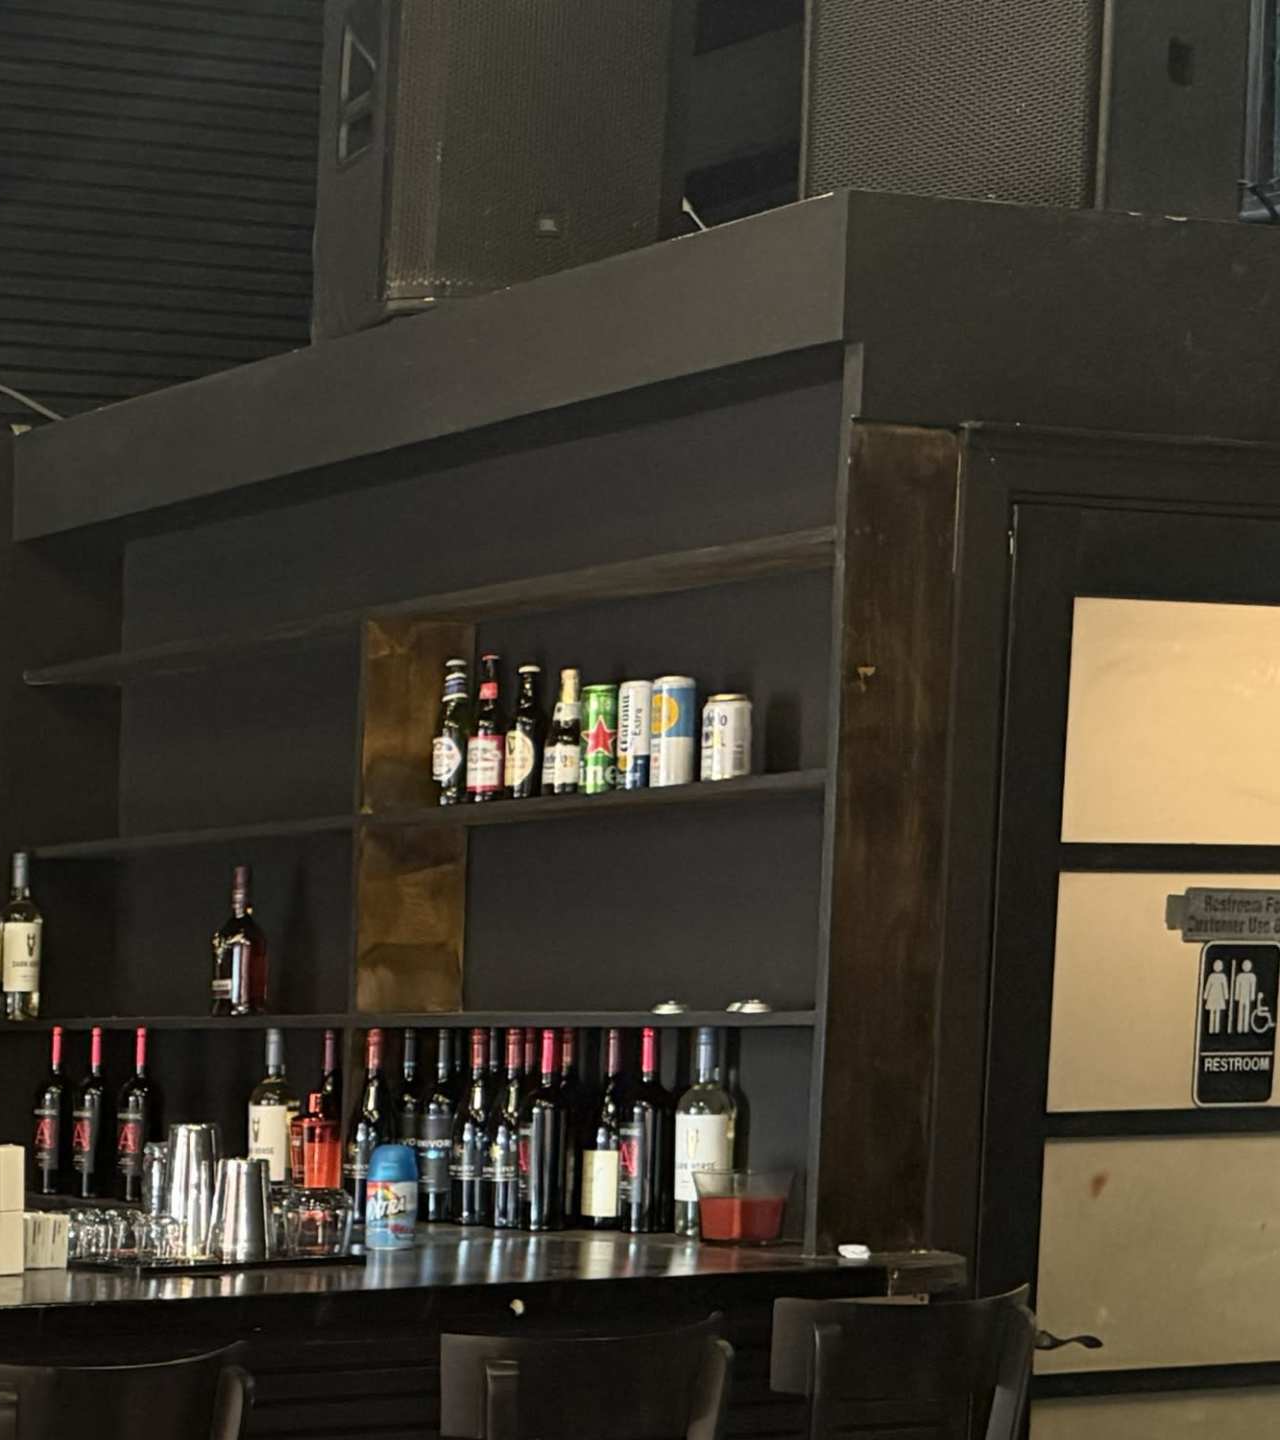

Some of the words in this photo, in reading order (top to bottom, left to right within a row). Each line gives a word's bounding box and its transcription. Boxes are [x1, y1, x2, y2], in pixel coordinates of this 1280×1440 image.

[632, 707, 643, 736] Extra
[1265, 896, 1280, 914] Fo
[1204, 1057, 1270, 1071] RESTROOM
